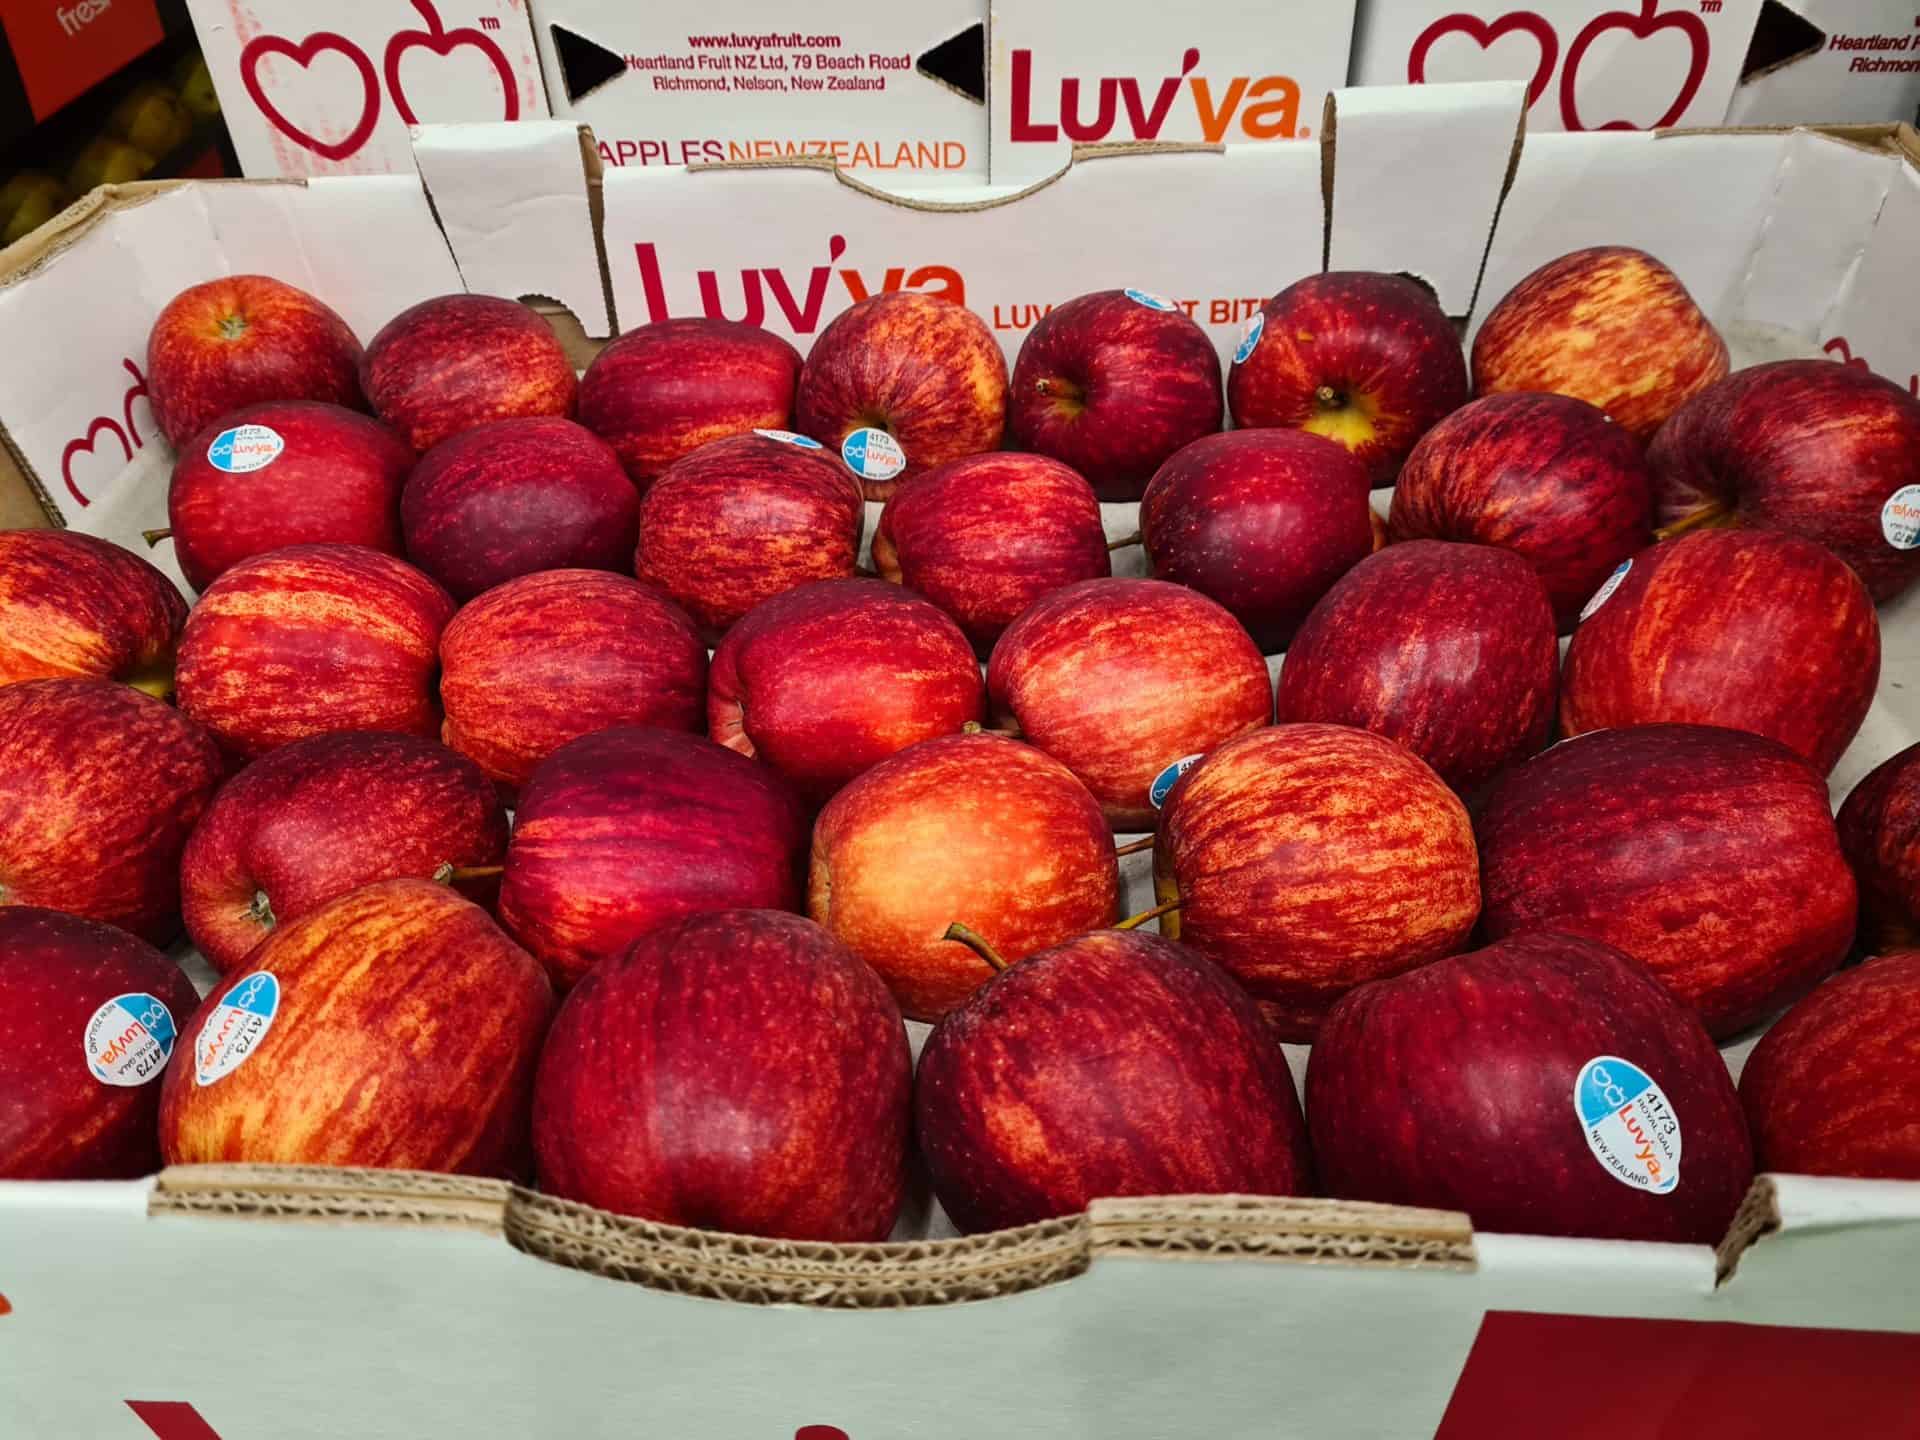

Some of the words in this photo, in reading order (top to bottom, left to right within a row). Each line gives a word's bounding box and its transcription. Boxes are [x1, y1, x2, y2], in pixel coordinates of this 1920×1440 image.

[687, 32, 842, 50] www.luvyafruit.com
[1829, 33, 1911, 51] Heartland
[623, 53, 694, 70] Heartland
[697, 54, 731, 70] Fruit
[734, 54, 758, 70] NZ
[760, 54, 788, 72] Ltd,
[792, 54, 812, 70] 79
[815, 53, 865, 70] Beach
[868, 53, 911, 70] Road
[652, 75, 731, 92] Richmond,
[733, 75, 788, 92] Nelson,
[790, 75, 823, 91] New
[827, 75, 886, 91] Zealand
[235, 1017, 263, 1055] 4173
[136, 1047, 162, 1078] 4173
[1646, 1090, 1677, 1136] 4173
[1637, 1098, 1658, 1131] ROYAL
[1657, 1131, 1674, 1160] GALA
[1591, 1129, 1609, 1154] NEW
[1606, 1154, 1649, 1186] ZEALAND
